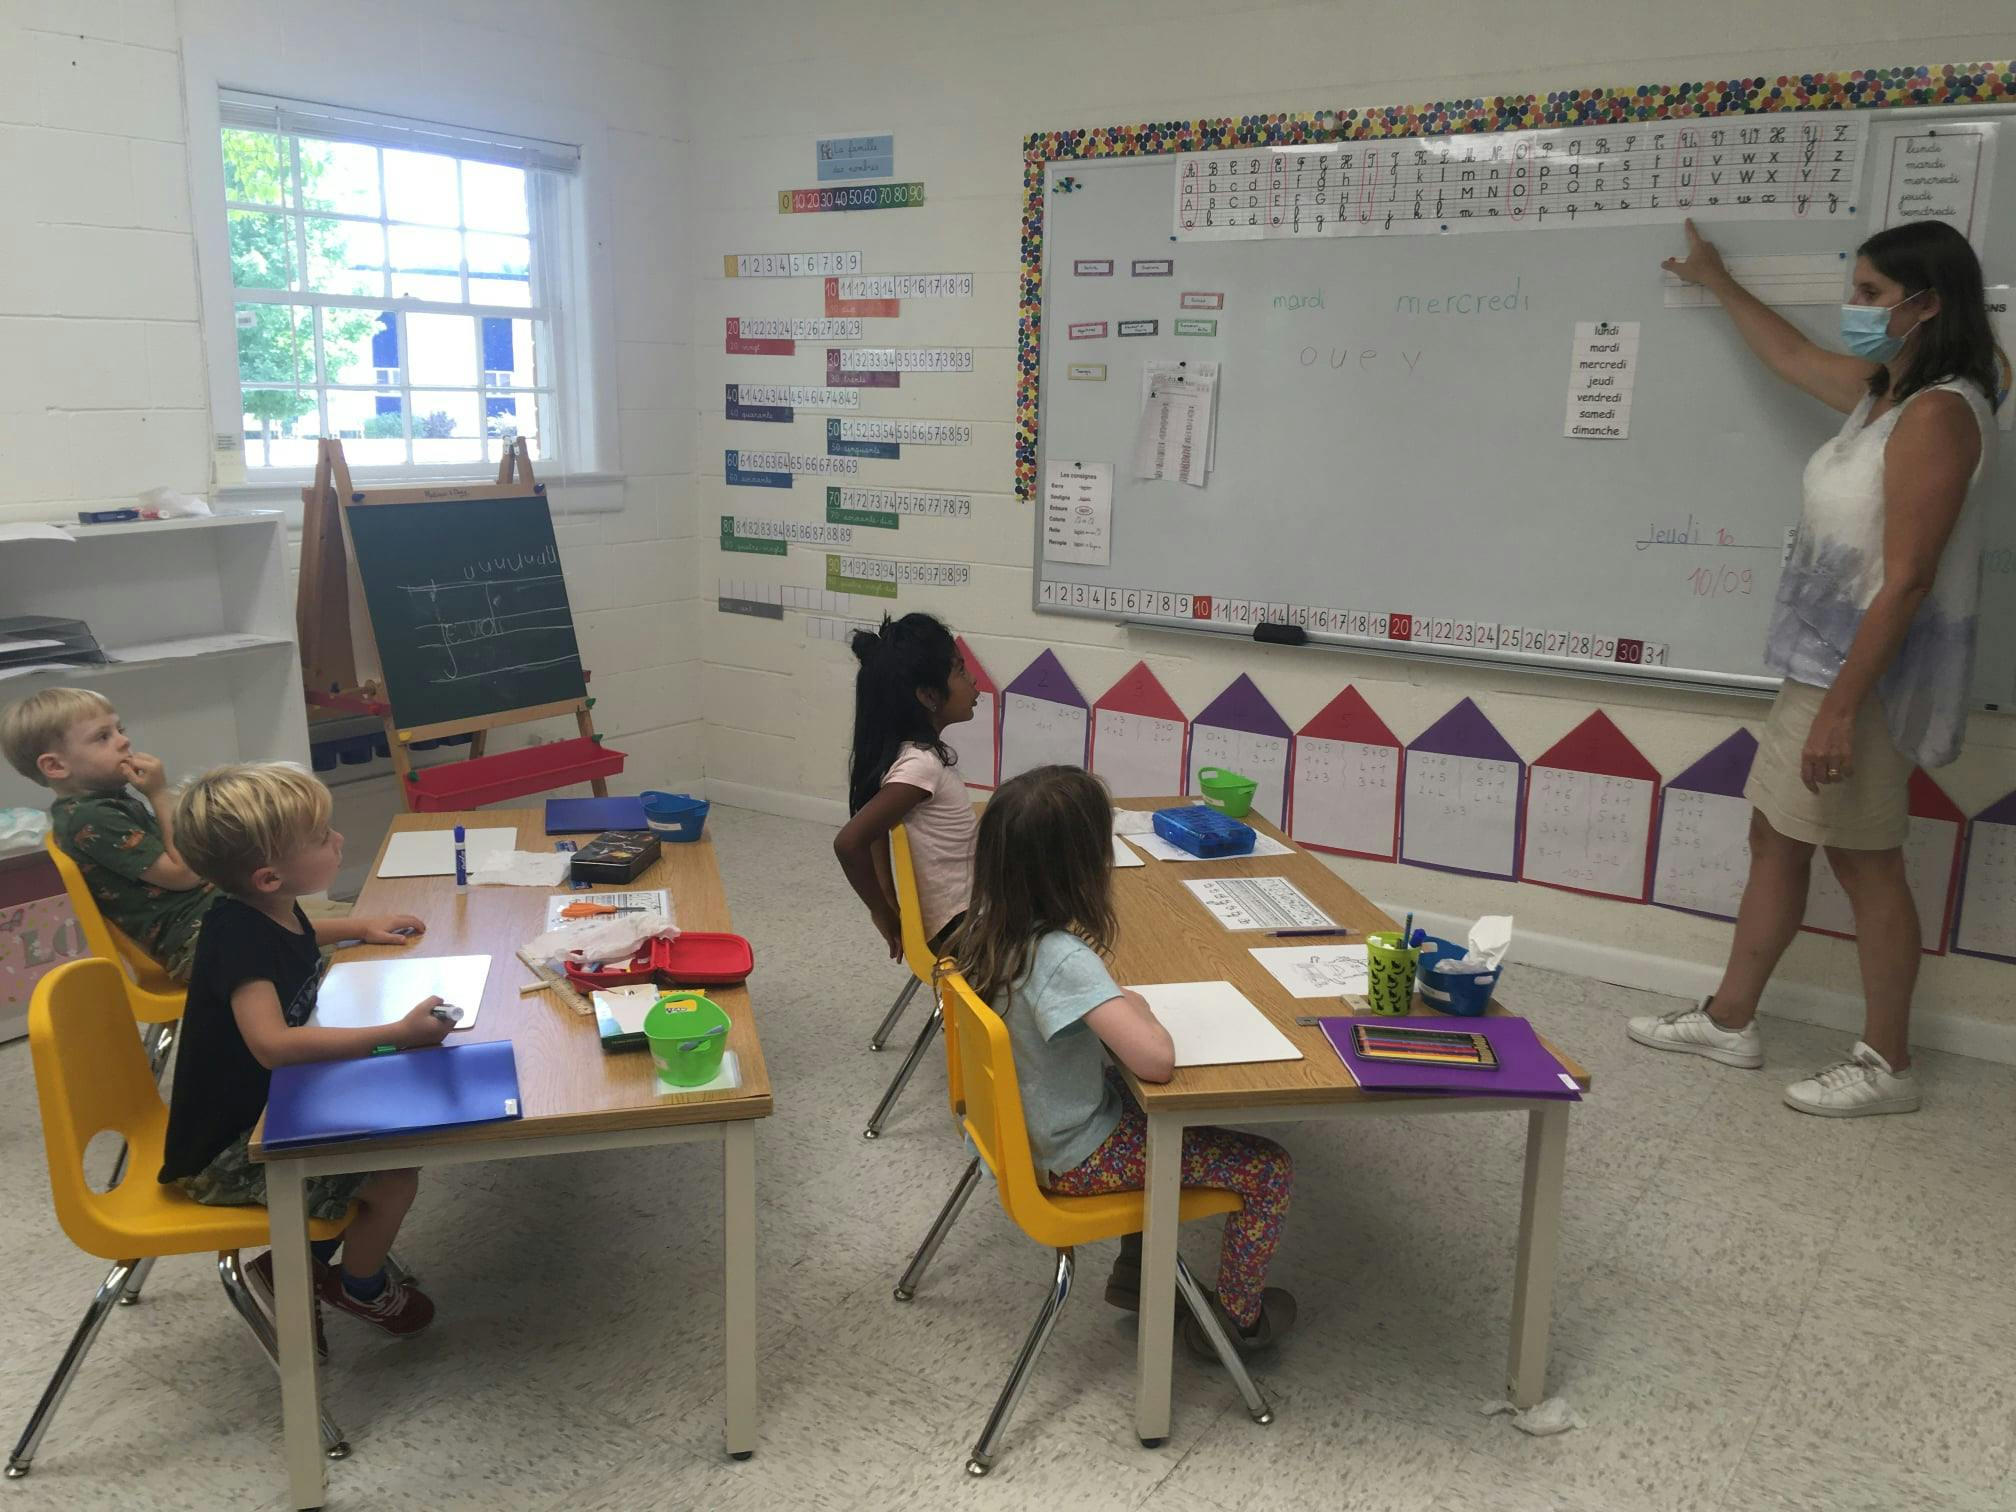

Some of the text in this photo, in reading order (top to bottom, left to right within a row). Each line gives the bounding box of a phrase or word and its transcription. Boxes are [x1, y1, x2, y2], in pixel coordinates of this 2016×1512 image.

[793, 194, 804, 209] 10
[807, 193, 819, 208] 20
[820, 193, 833, 207] 30
[834, 192, 847, 206] 40
[849, 190, 862, 204] 50
[863, 189, 876, 204] 60
[880, 188, 892, 203] 70
[894, 187, 907, 202] 80
[909, 186, 922, 201] 90
[1185, 200, 1192, 210] A
[1210, 198, 1215, 209] B
[1230, 197, 1238, 208] C
[1250, 197, 1258, 208] D
[1275, 195, 1280, 206] E
[1295, 194, 1300, 206] F
[1316, 193, 1325, 204] G
[1341, 192, 1348, 203] H
[1416, 189, 1423, 200] K
[1462, 187, 1473, 199] M
[1488, 186, 1497, 197] N
[1513, 185, 1525, 196] O
[1541, 183, 1548, 194] P
[1596, 179, 1603, 191] R
[1623, 177, 1629, 190] S
[1652, 175, 1659, 188] T
[741, 255, 857, 272] 1 2 3 4 5 6 7 8 9
[826, 278, 970, 296] 10 11 12 13 14 15 16 17 18 19
[1397, 276, 1528, 314] mercredi
[1595, 326, 1619, 335] lundi
[1590, 343, 1620, 352] mardi
[1580, 360, 1626, 369] mercredi
[1587, 376, 1614, 388] jeudi
[1577, 393, 1622, 402] vendredi
[1580, 409, 1616, 418] samedi
[1572, 425, 1619, 435] dimanche
[828, 492, 970, 514] 70 71 72 73 74 75 76 77 78 79
[1044, 585, 1665, 664] 1 2 3 4 5 6 7 8 9 10 11 12 13 14 15 16 17 18 19 20 21 22 23 24 25 26 27 28 29 30 31
